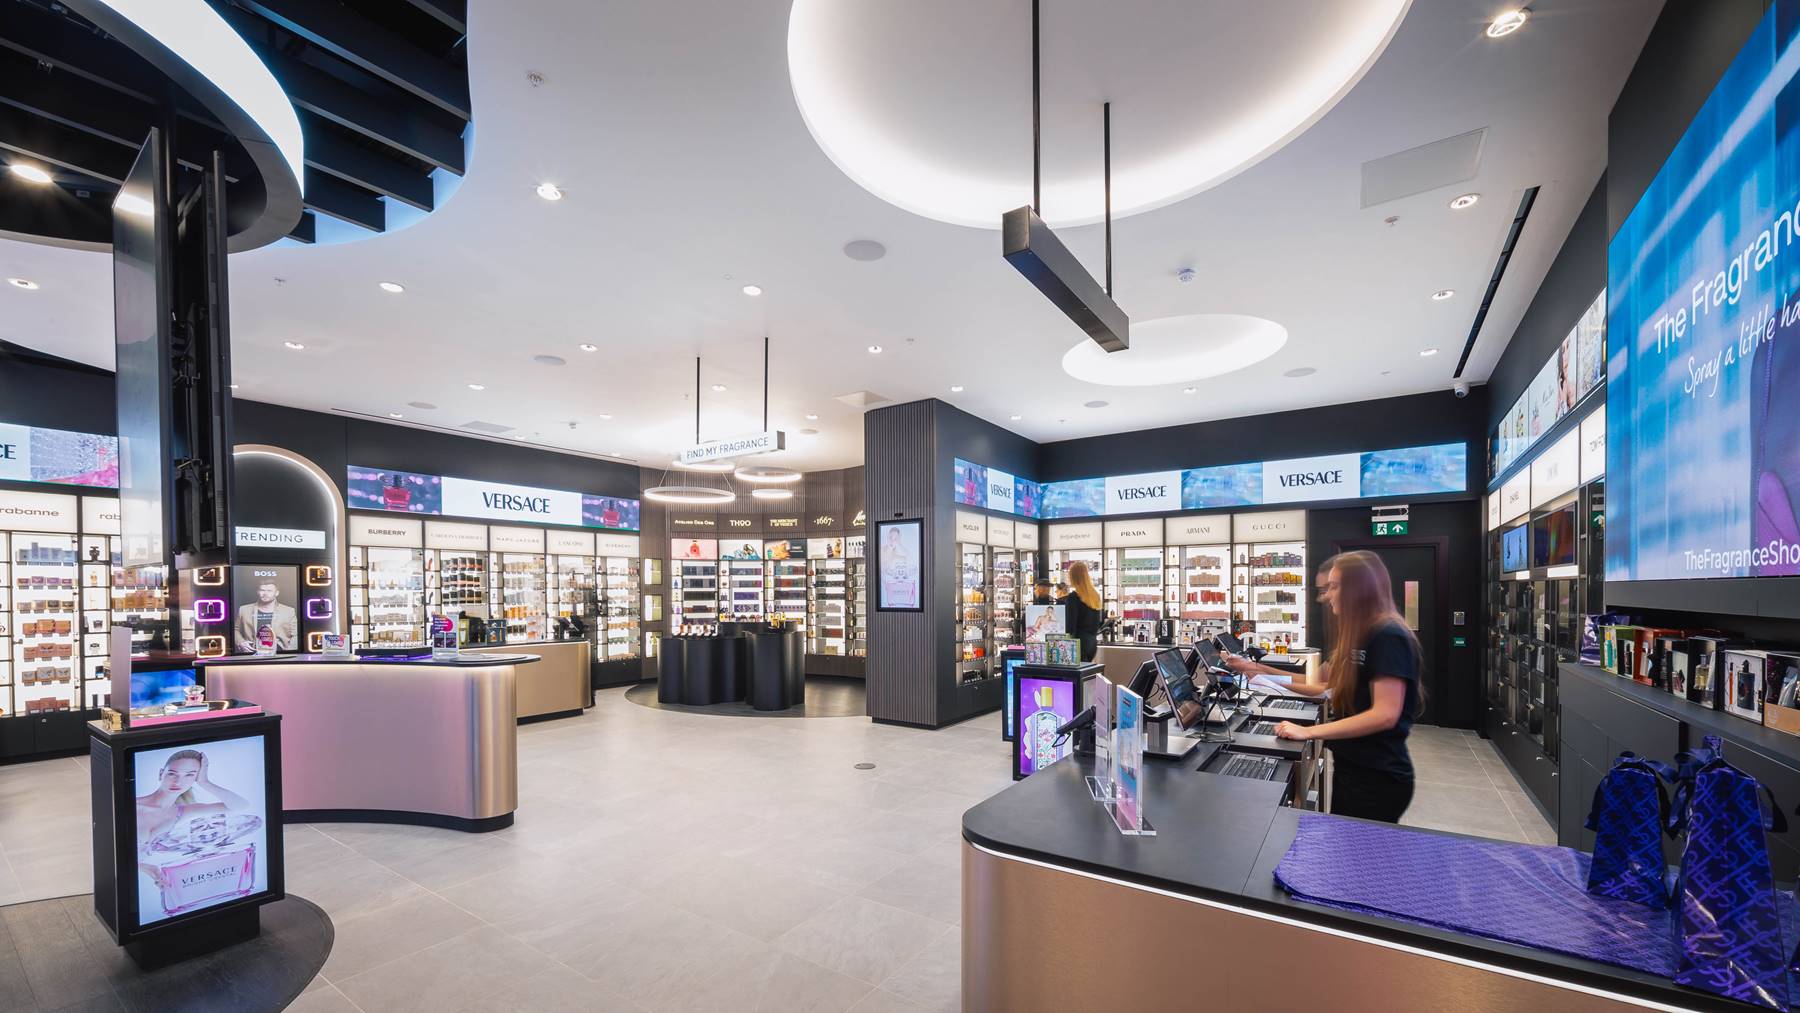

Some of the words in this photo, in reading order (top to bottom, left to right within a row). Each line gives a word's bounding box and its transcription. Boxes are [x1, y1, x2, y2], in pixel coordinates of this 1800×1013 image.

[1654, 307, 1687, 354] The
[1684, 349, 1722, 400] Spray
[1724, 343, 1735, 367] a
[1738, 302, 1776, 359] little
[686, 448, 704, 459] FIND
[706, 446, 718, 456] MY
[719, 436, 768, 454] FRAGRANCE
[1279, 469, 1343, 488] VERSACE
[990, 482, 1011, 500] VERSACE
[1117, 485, 1167, 501] VERSACE
[482, 491, 551, 514] VERSACE
[0, 507, 60, 517] rabanne
[367, 528, 407, 537] BURBERRY
[1185, 527, 1211, 536] ARMANI
[1251, 524, 1287, 532] GUCCI
[236, 531, 303, 544] RENDING
[1684, 538, 1800, 574] TheFragranceSho
[181, 866, 235, 884] VERSACE
